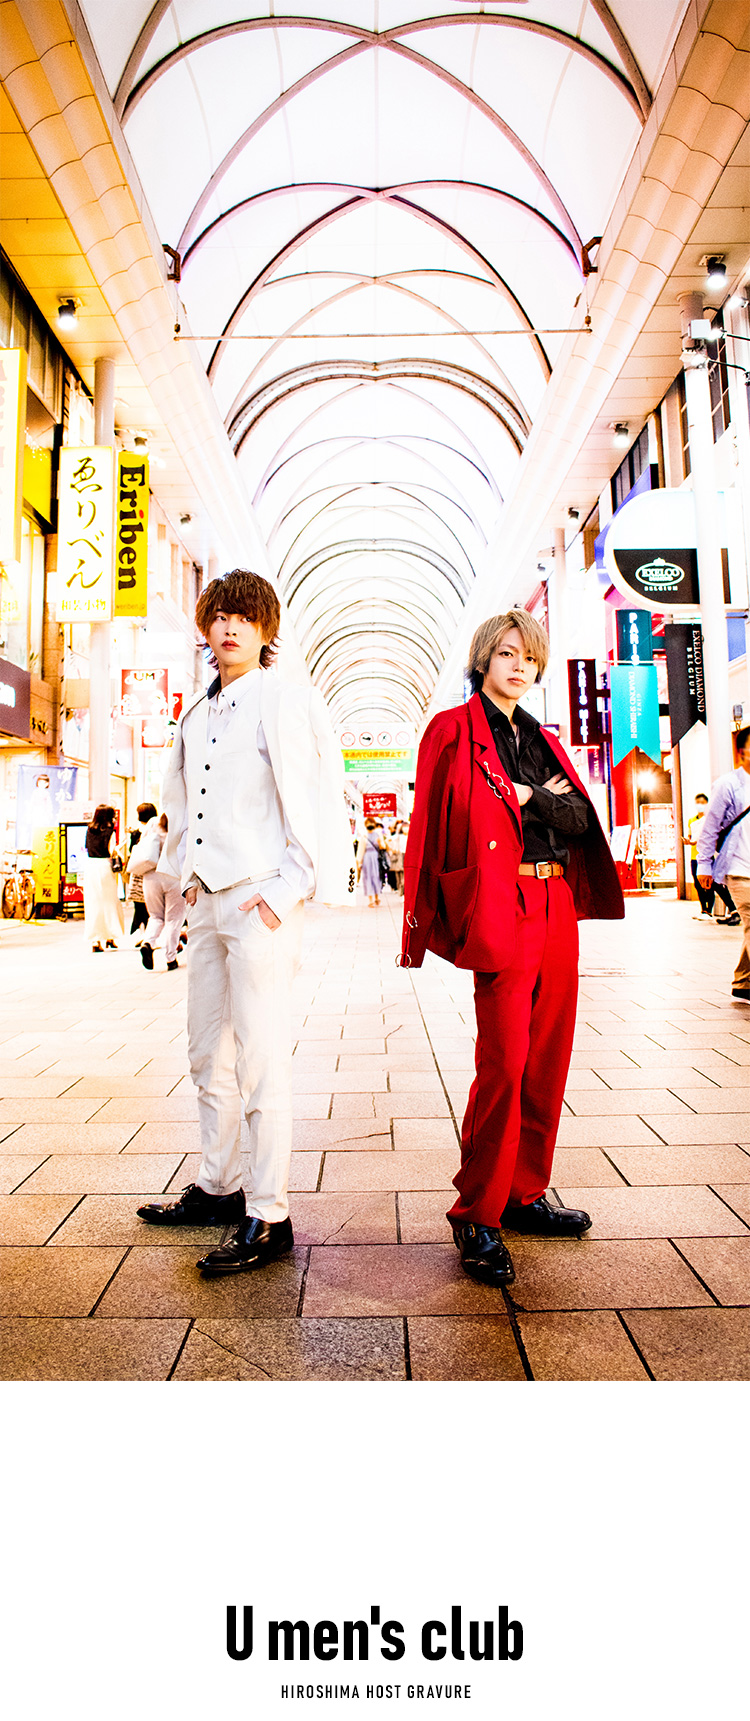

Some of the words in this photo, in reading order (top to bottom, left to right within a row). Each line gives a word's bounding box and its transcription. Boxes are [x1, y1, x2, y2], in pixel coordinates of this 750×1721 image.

[66, 456, 105, 589] ゑりべん
[118, 463, 145, 590] Eriben
[692, 630, 702, 665] EXELCO
[577, 661, 588, 705] PARIS
[628, 671, 636, 705] DIAMOND
[687, 647, 696, 695] BELGIUM
[695, 667, 705, 713] DIAMOND
